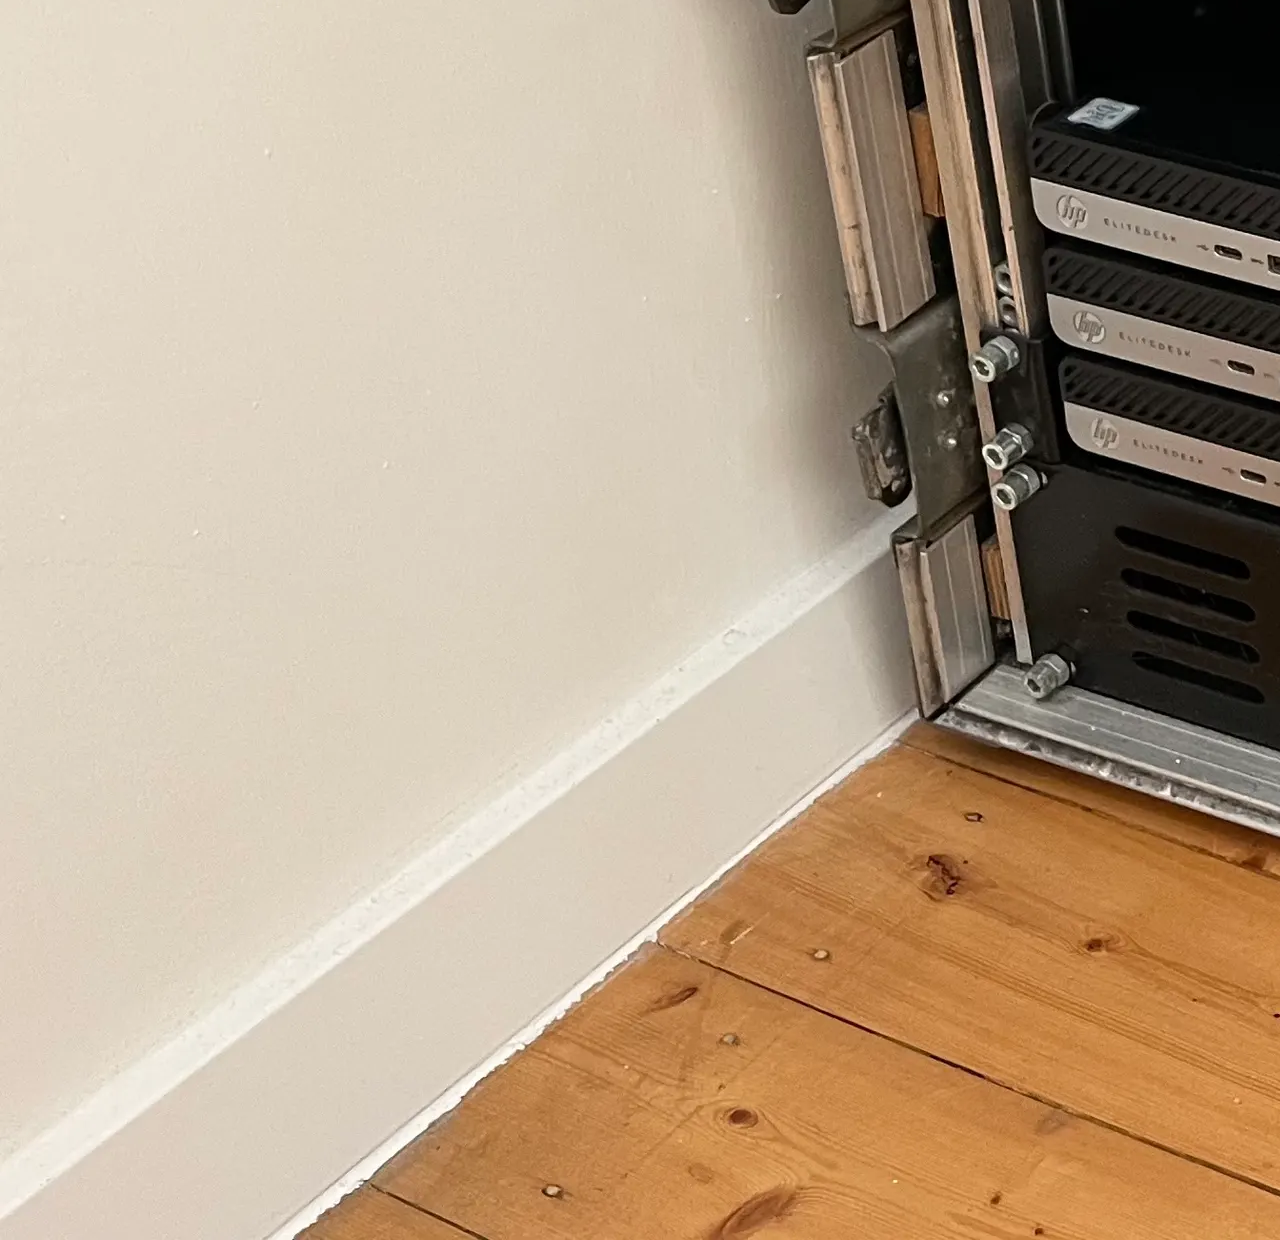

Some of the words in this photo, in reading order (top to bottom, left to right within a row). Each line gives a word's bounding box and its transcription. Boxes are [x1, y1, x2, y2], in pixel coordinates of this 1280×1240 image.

[1060, 194, 1087, 229] hp
[1103, 217, 1177, 242] ELITEDESK
[1077, 311, 1105, 343] hp
[1118, 331, 1192, 358] ELITEDESK
[1093, 417, 1118, 449] hp
[1133, 438, 1205, 465] ELITEDESK
